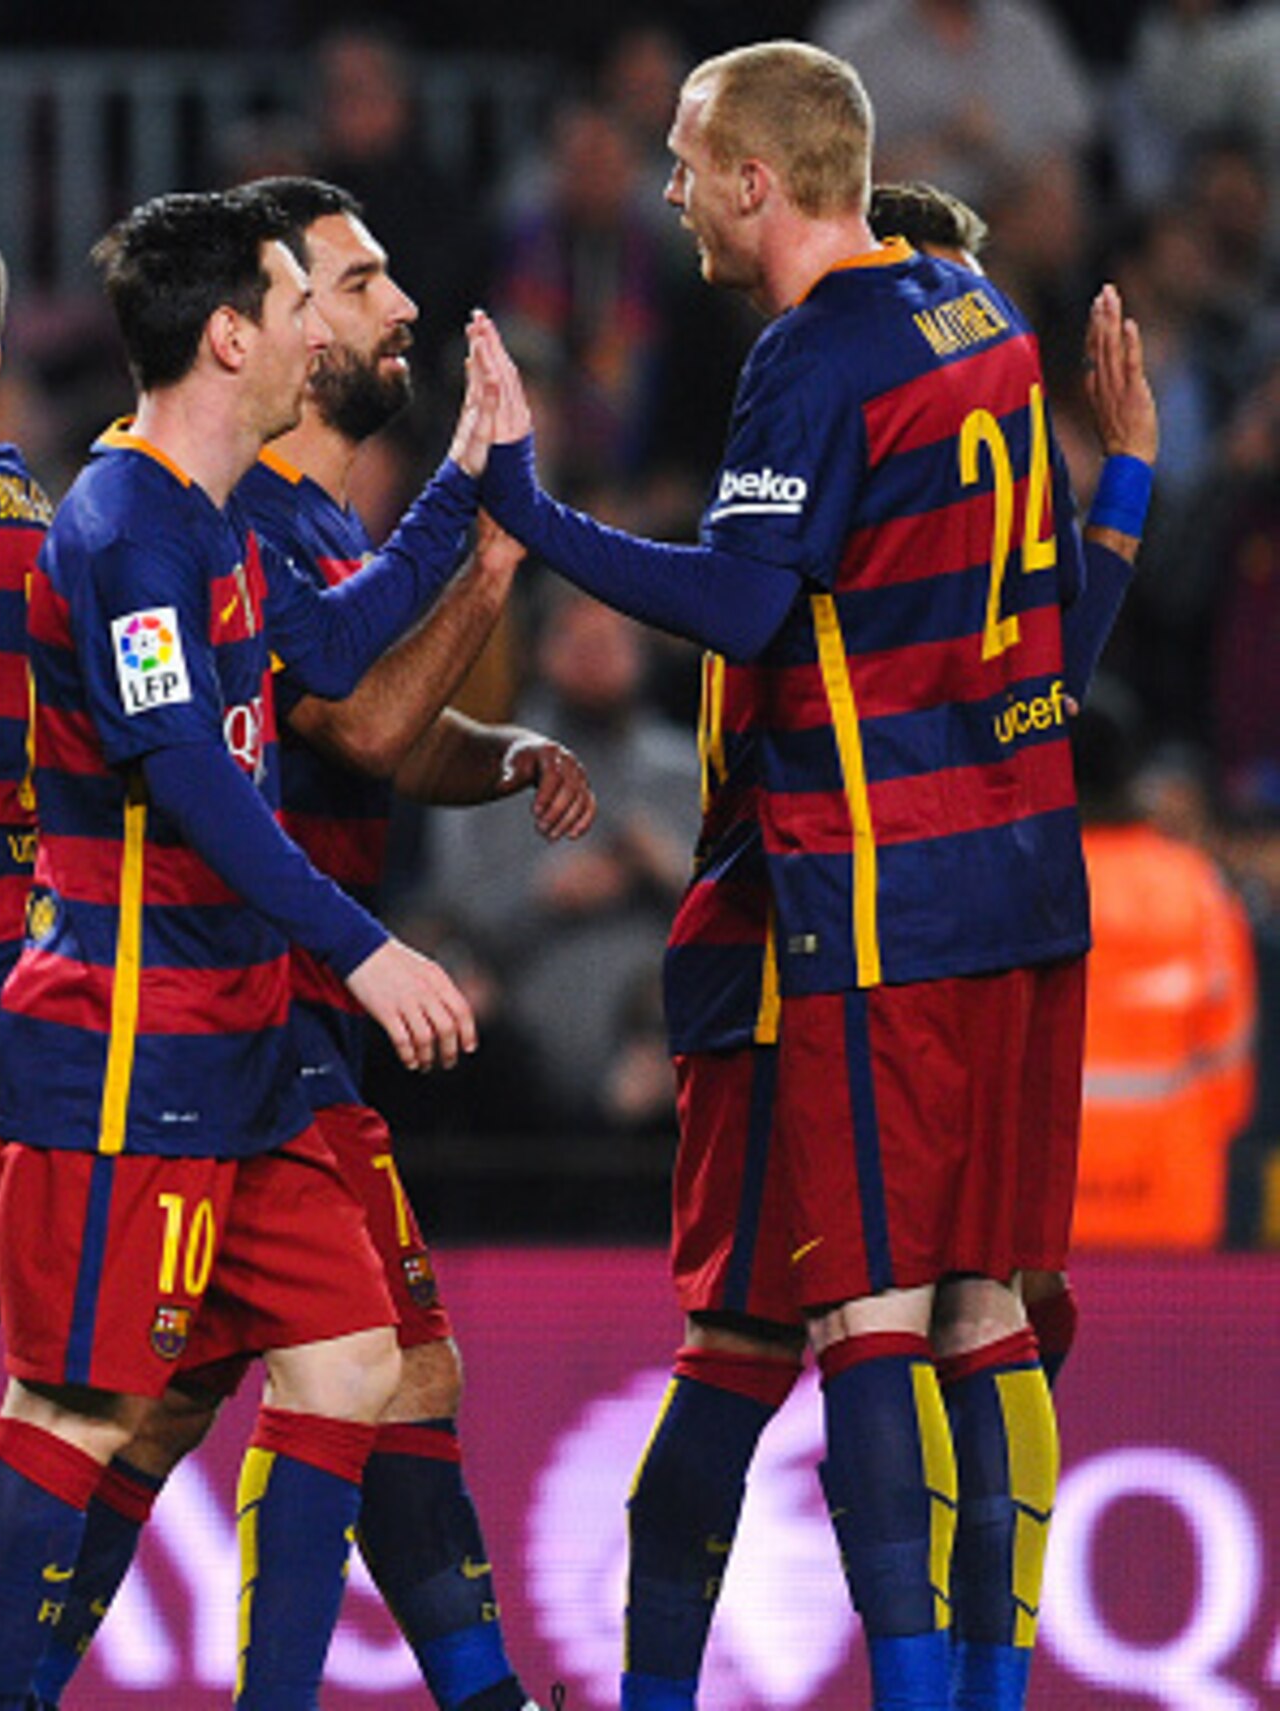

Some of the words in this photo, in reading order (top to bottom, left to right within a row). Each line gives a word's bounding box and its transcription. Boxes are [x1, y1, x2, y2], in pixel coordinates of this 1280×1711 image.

[720, 468, 807, 502] beko
[958, 382, 1057, 661] 24
[128, 671, 179, 708] LFP
[158, 1193, 215, 1296] 10
[372, 1154, 410, 1247] 7
